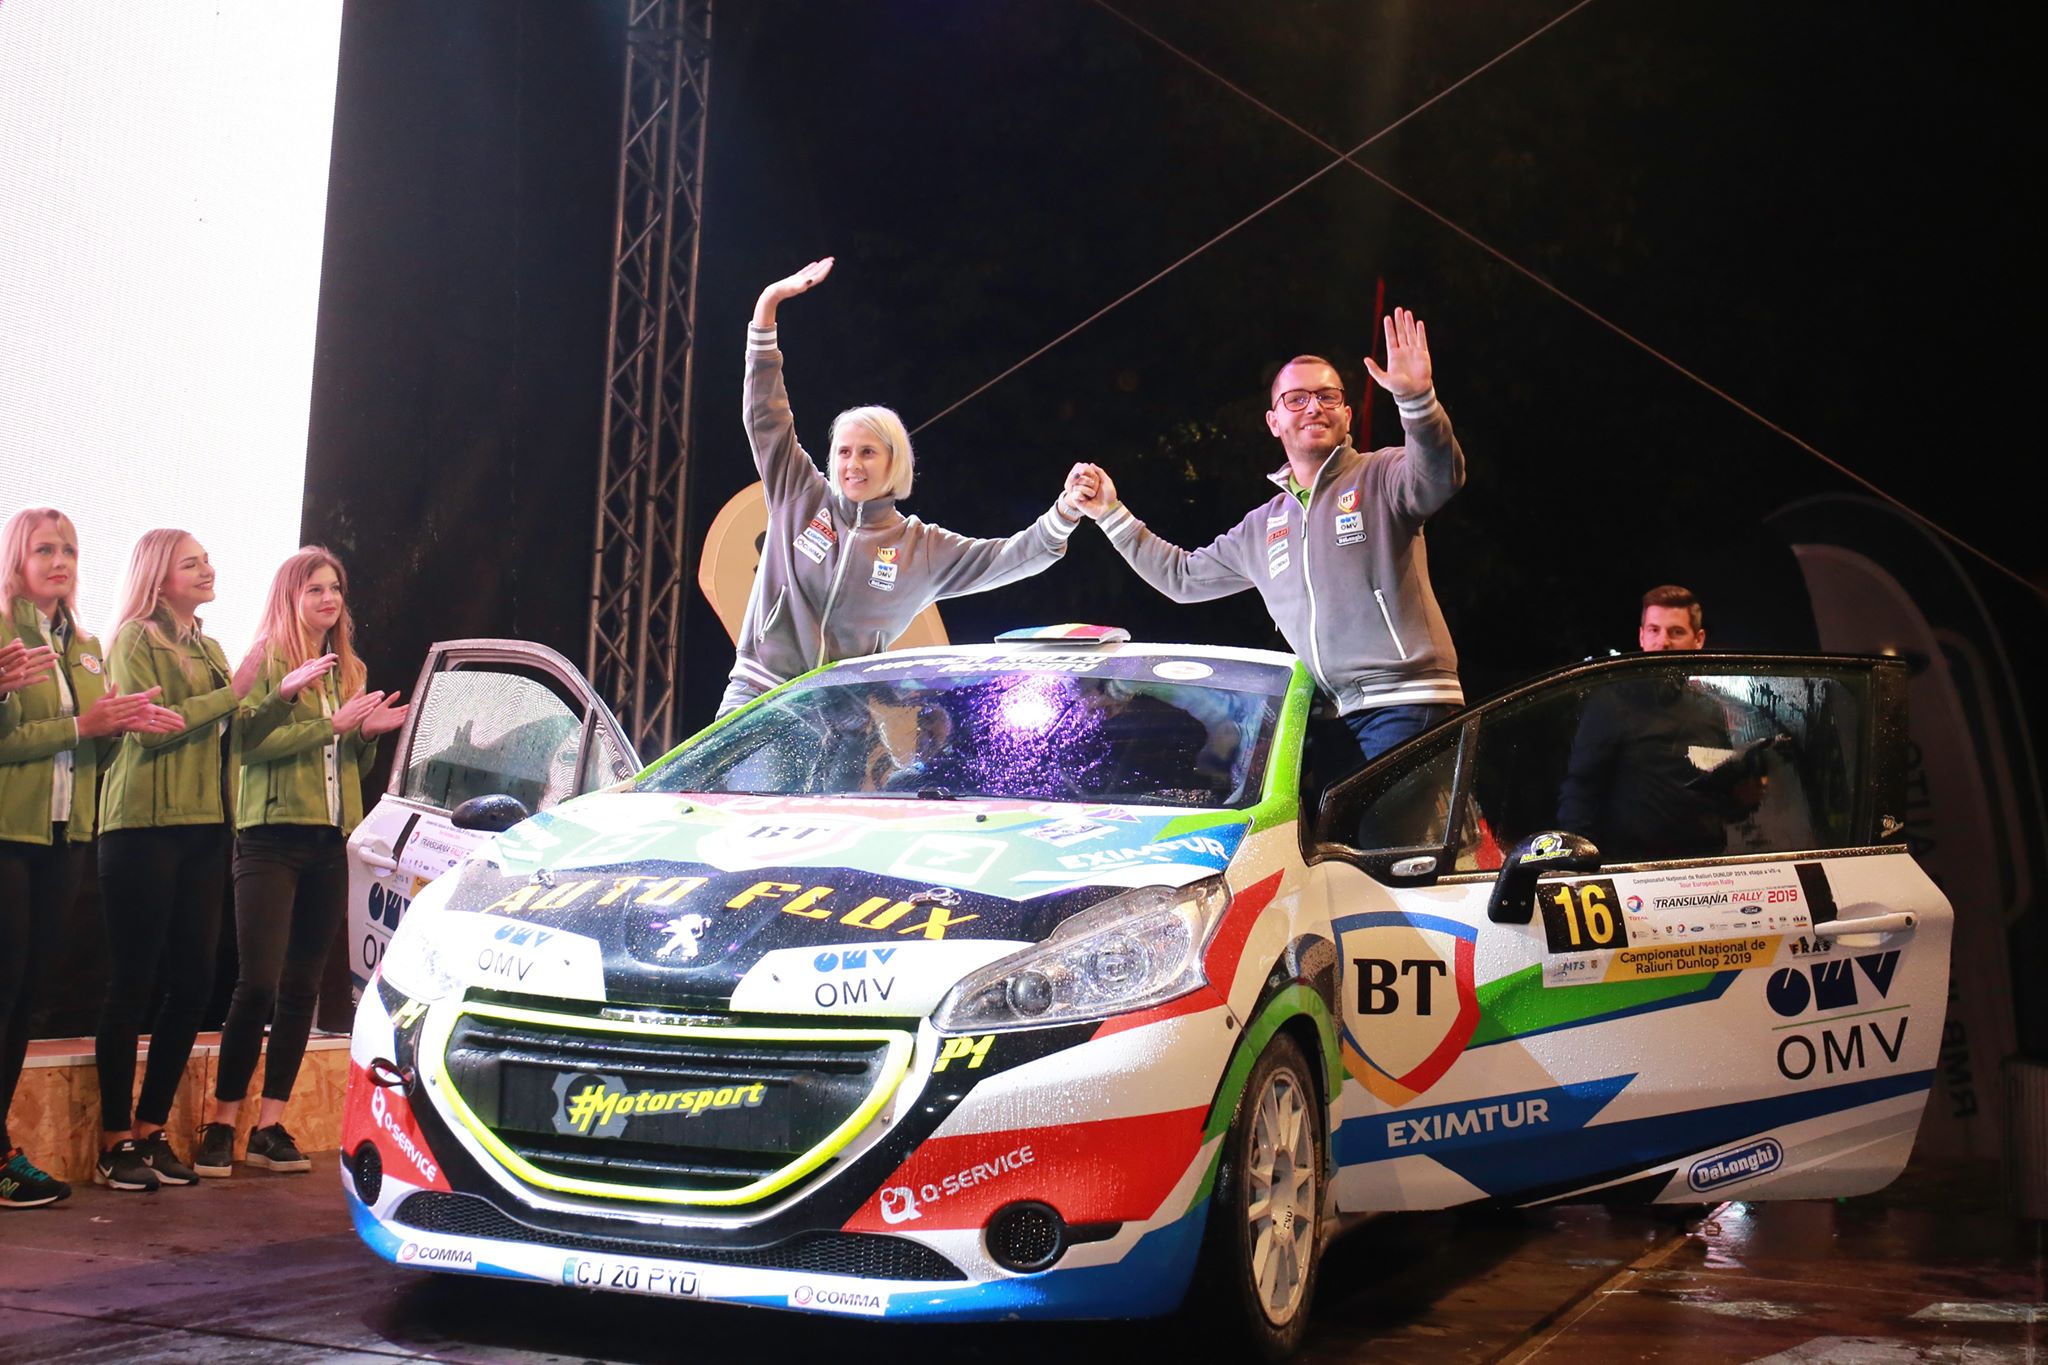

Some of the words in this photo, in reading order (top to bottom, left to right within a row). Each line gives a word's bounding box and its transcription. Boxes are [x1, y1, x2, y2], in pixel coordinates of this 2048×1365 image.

[1341, 522, 1358, 531] OMV
[1057, 836, 1230, 873] EXIMTUR
[482, 876, 710, 914] AUTO
[724, 881, 981, 941] FLUX
[1554, 884, 1614, 946] 16
[1655, 893, 1728, 909] TRANSILVANIA
[1732, 891, 1763, 903] RALLY
[1767, 889, 1797, 904] 2019
[479, 949, 533, 981] OMV
[1621, 946, 1695, 964] Campionatul
[1751, 939, 1766, 950] de
[1636, 960, 1672, 975] Raliuri
[1677, 957, 1719, 970] Dunlop
[1724, 952, 1752, 966] 2019
[815, 976, 895, 1007] OMV
[1353, 958, 1446, 1016] BT
[933, 1035, 995, 1072] P1
[1777, 1016, 1909, 1080] OMV
[567, 1082, 764, 1132] #Motorsport
[1387, 1099, 1549, 1148] EXIMTUR
[418, 1246, 473, 1264] COMMA
[577, 1261, 603, 1285] CJ
[610, 1265, 638, 1289] 20
[648, 1270, 697, 1295] PYD
[814, 1290, 881, 1310] COMMA
